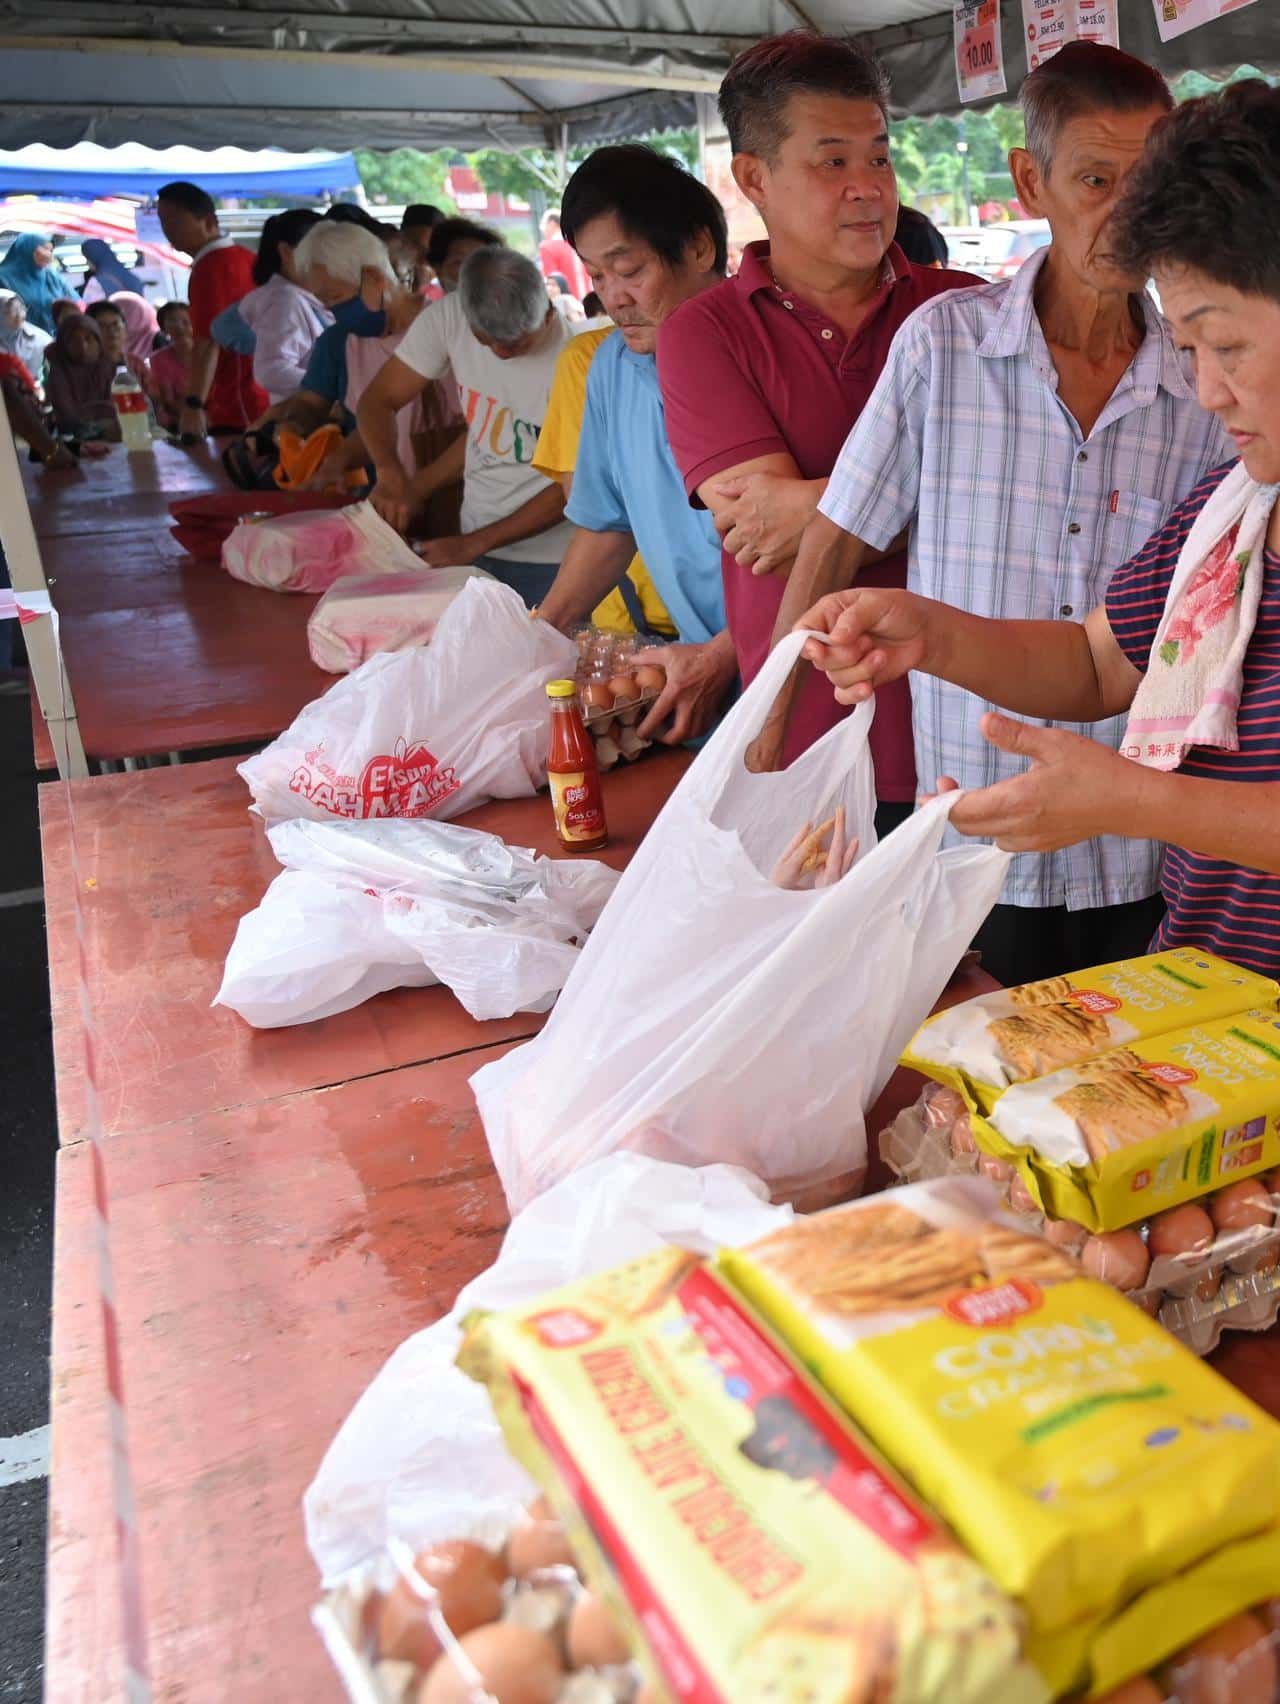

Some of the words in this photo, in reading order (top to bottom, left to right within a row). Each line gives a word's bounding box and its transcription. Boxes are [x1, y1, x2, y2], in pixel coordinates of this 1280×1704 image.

[967, 40, 993, 71] 10.00
[369, 764, 433, 793] Ehsan
[933, 1318, 1117, 1379] CORN
